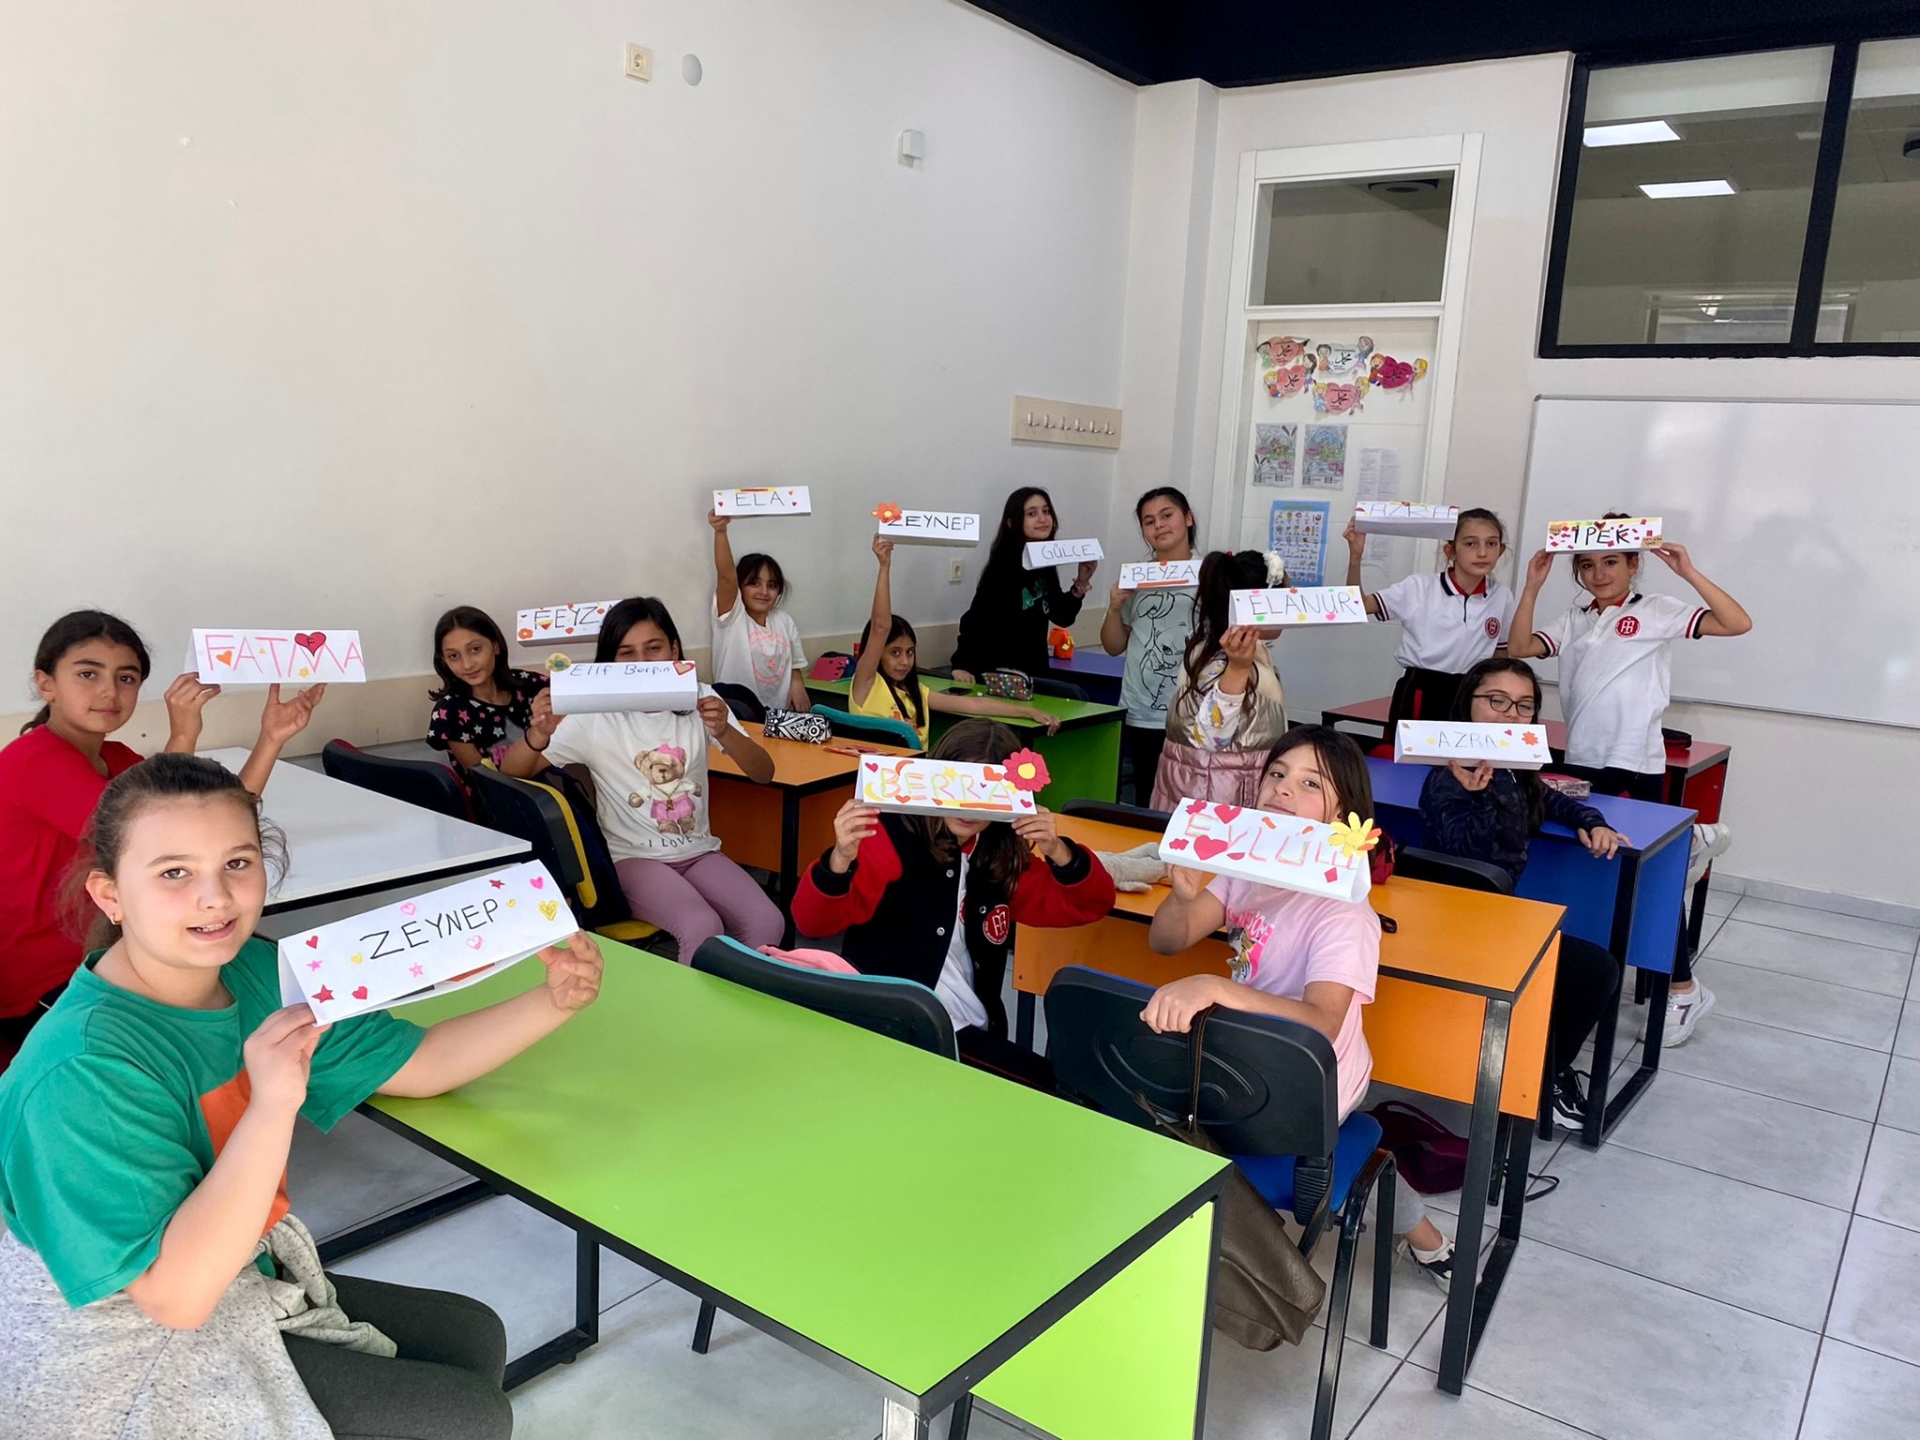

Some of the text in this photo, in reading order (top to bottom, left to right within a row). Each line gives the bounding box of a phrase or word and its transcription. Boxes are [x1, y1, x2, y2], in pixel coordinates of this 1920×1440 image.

[735, 491, 785, 507] ELA
[1131, 564, 1198, 582] BEYZA
[1249, 593, 1357, 616] ELANUR
[534, 604, 613, 631] FEYZ
[205, 634, 365, 678] FATMA
[1438, 731, 1497, 749] AZRA
[881, 767, 1014, 804] BERRA
[359, 898, 499, 960] ZEYNEP
